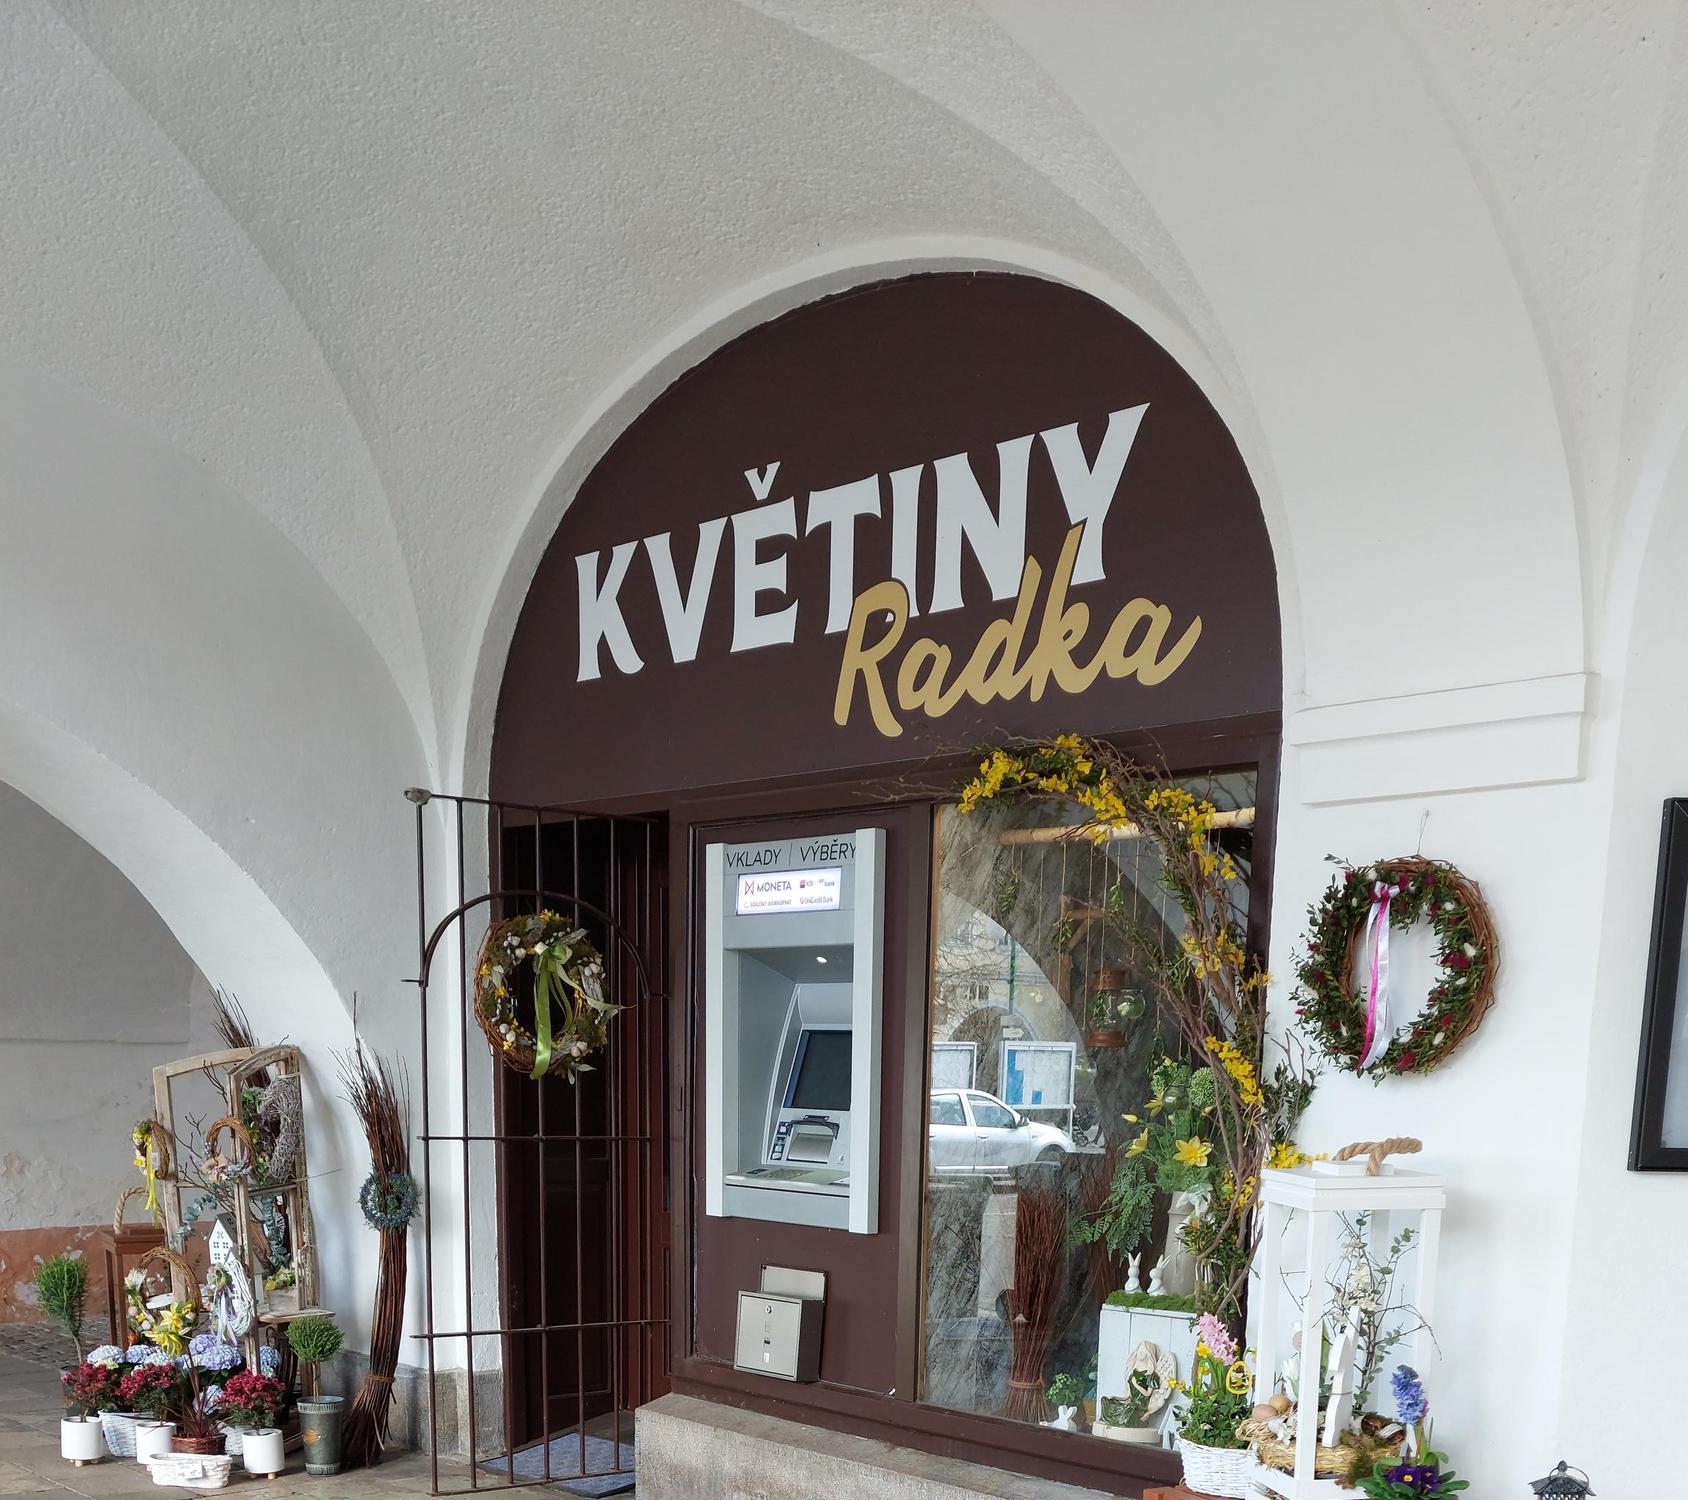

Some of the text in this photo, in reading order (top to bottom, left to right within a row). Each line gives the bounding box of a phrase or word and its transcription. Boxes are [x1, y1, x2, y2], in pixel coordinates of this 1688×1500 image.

[574, 402, 1151, 682] KVĚTINY
[833, 523, 1202, 737] Radka
[726, 838, 856, 868] VKLADY VÝBĚRY
[756, 880, 792, 893] MONETA
